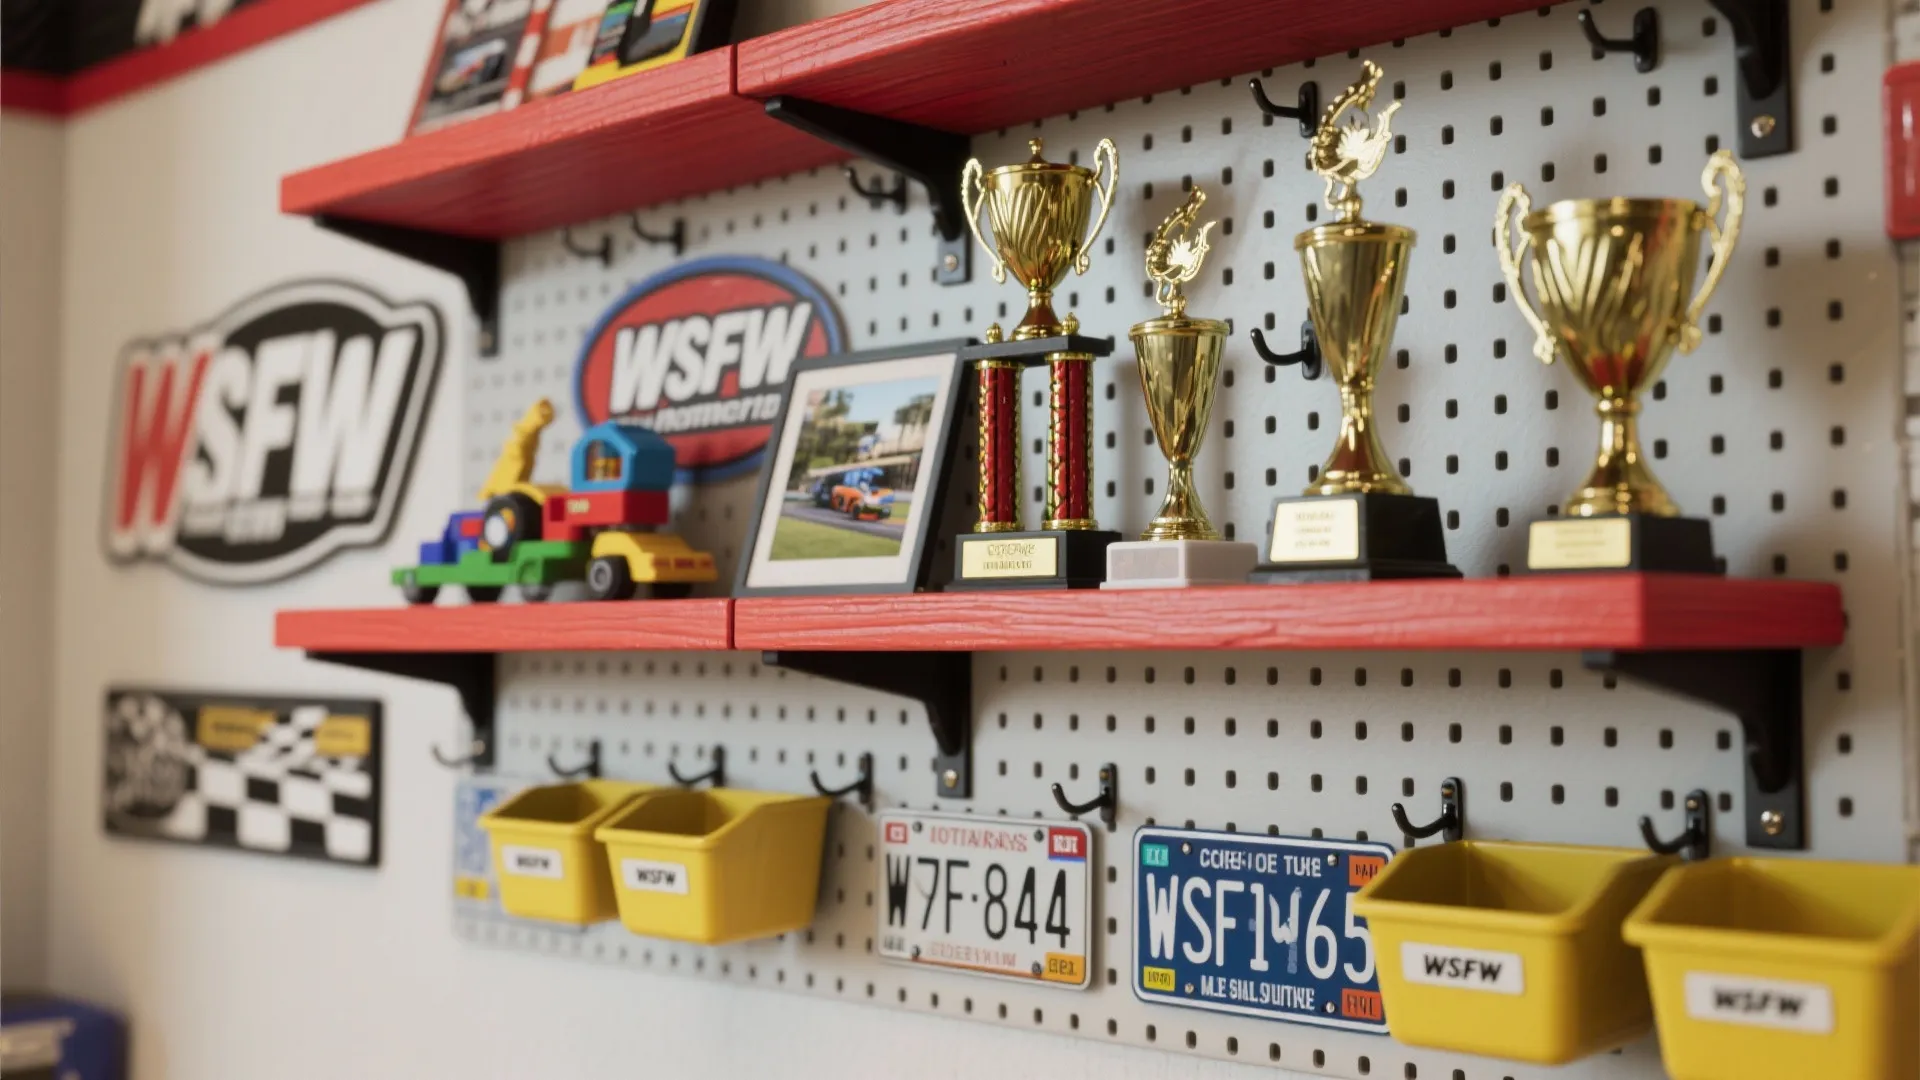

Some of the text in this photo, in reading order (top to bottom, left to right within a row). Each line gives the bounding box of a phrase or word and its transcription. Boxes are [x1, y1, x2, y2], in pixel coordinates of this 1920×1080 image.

[610, 302, 812, 414] WSFW
[110, 328, 417, 540] WSFW
[636, 868, 676, 886] WSFW
[1424, 954, 1502, 982] WSFW
